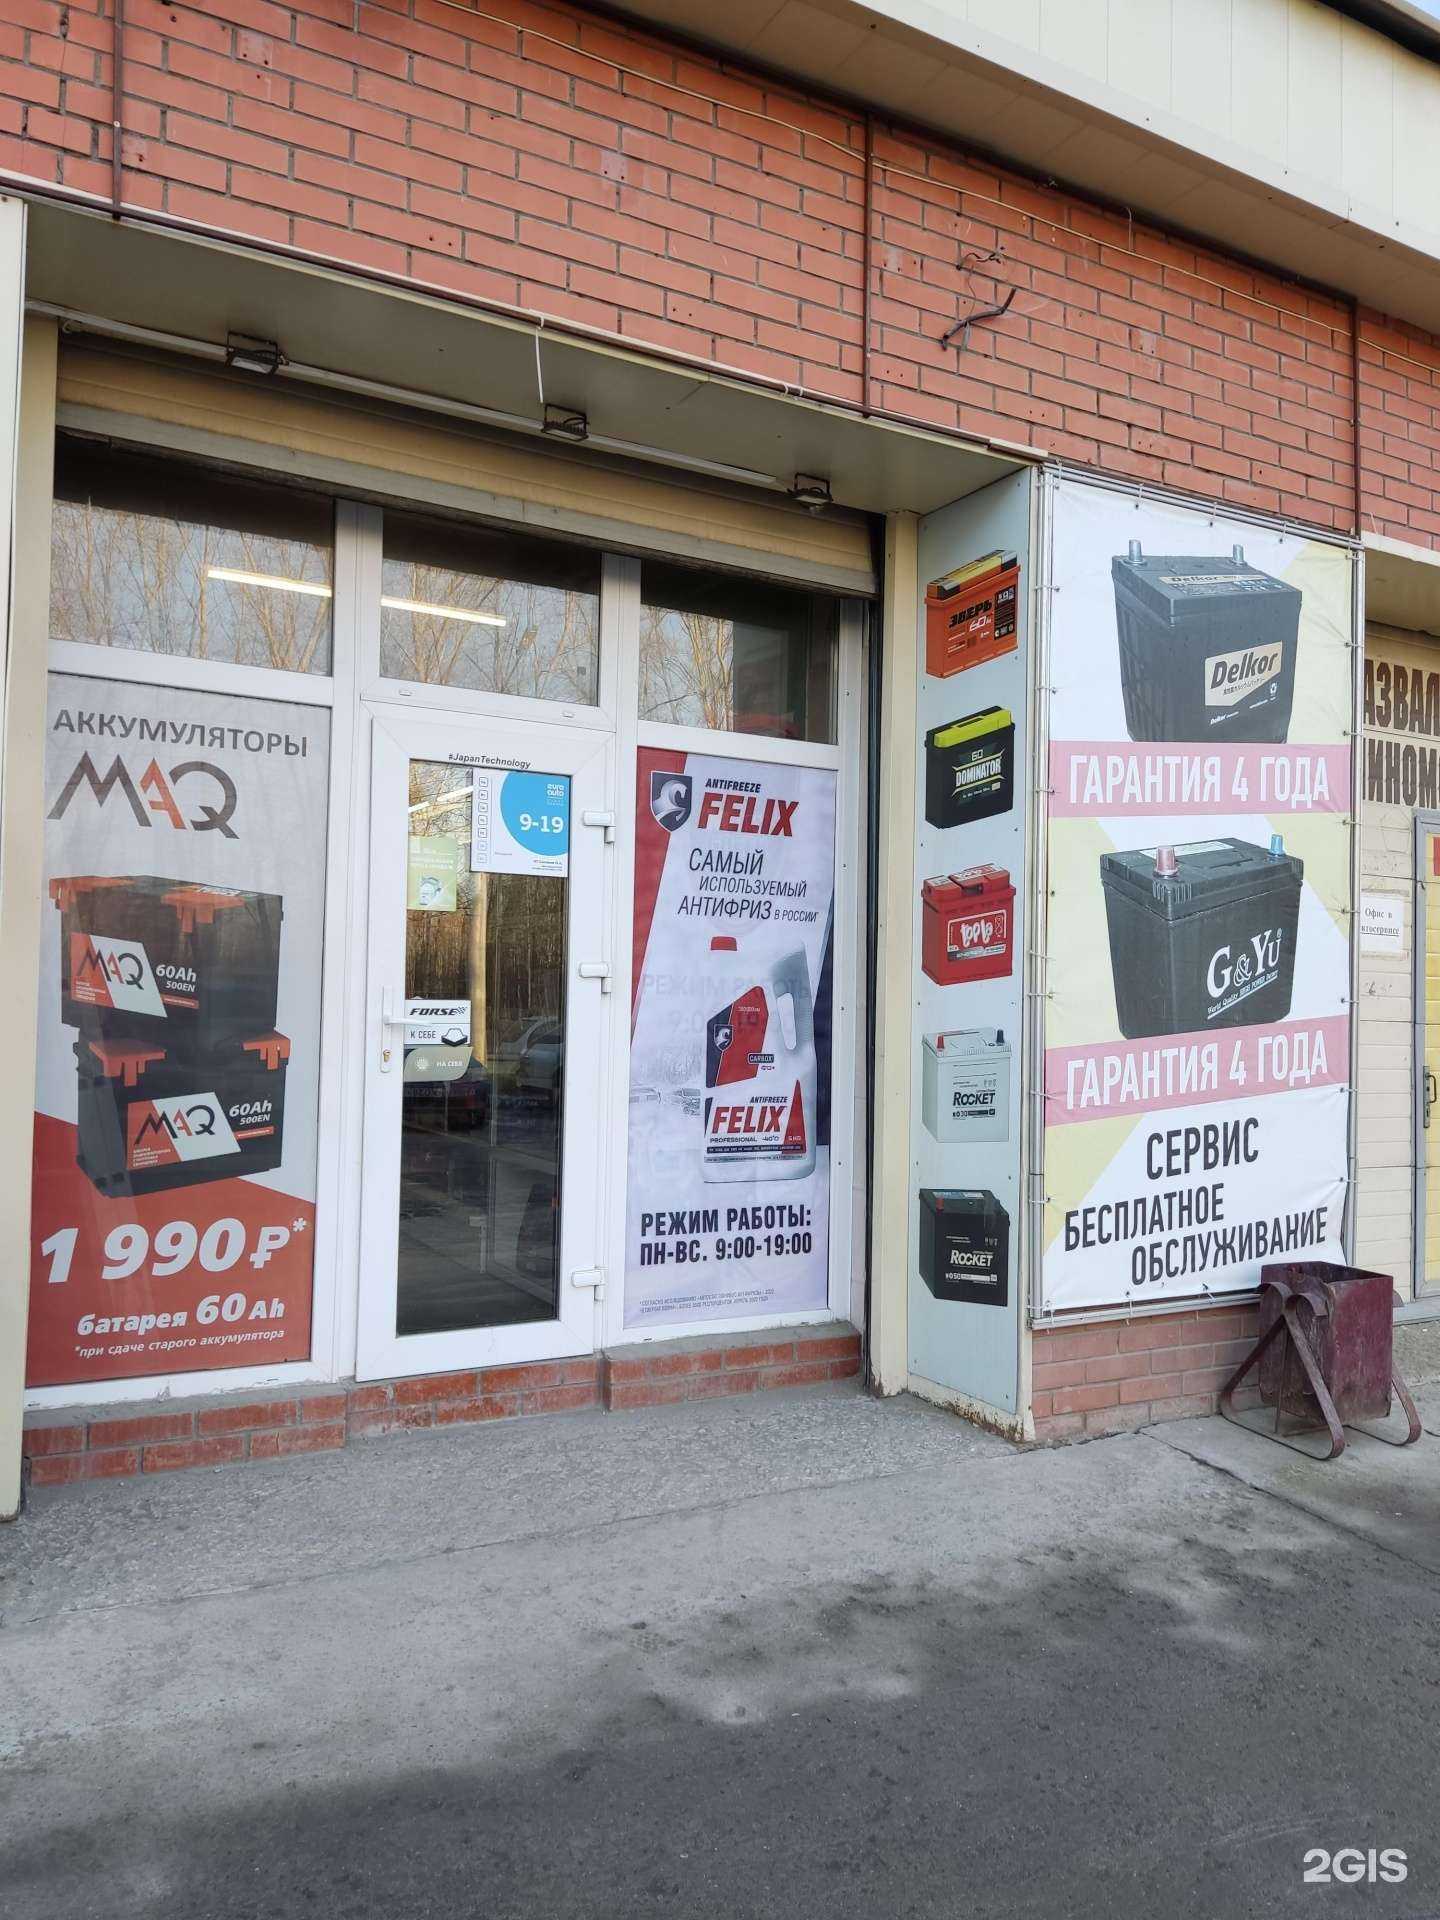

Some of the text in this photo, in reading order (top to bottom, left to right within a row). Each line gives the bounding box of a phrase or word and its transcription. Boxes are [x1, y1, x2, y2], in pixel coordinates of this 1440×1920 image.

[1210, 651, 1278, 689] Delkor
[52, 709, 308, 758] АККУМУЛЯТОРЫ
[448, 753, 531, 769] #JapanTechnology
[956, 758, 1002, 788] DOMINATOR
[1363, 738, 1440, 809] ИНОМ
[47, 750, 240, 839] MAQ
[705, 778, 761, 793] ANTIFREEZE
[1069, 755, 1330, 809] ГАРАНТИЯ 4 ГОДА
[520, 813, 564, 834] 9-19
[697, 792, 799, 837] FELIX
[689, 847, 765, 876] САМЫЙ
[699, 876, 807, 898] ИСПОЛЬЗУЕМЫЙ
[678, 895, 772, 920] АНТИФРИЗ
[774, 910, 780, 920] В
[1364, 907, 1384, 919] Офис
[77, 947, 145, 991] MAQ
[155, 964, 197, 983] 60Ah
[165, 981, 196, 993] 500EN
[409, 1007, 458, 1016] FORSE
[410, 1030, 437, 1039] К СЕБЕ
[1066, 1030, 1328, 1110] ГАРАНТИЯ 4 ГОДА
[229, 1100, 273, 1118] 60Ah
[750, 1096, 788, 1104] ANTIFREEZE
[134, 1104, 215, 1146] MAQ
[239, 1114, 271, 1126] 500EN
[712, 1106, 787, 1134] FELIX
[710, 1136, 757, 1144] PROFESSIONAL
[1146, 1117, 1259, 1180] СЕРВИС
[641, 1204, 811, 1237] РЕЖИМ РАБОТЫ:
[1065, 1182, 1225, 1252] БЕСПЛАТНОЕ
[41, 1227, 79, 1283] 1
[640, 1232, 812, 1266] ПН-ВС. 9:00-19:00
[1132, 1206, 1328, 1286] ОБСЛУЖИВАНИЕ
[77, 1311, 187, 1336] батарея
[108, 1342, 144, 1355] сдаче
[149, 1337, 196, 1352] старого
[200, 1329, 285, 1346] аккумулятора
